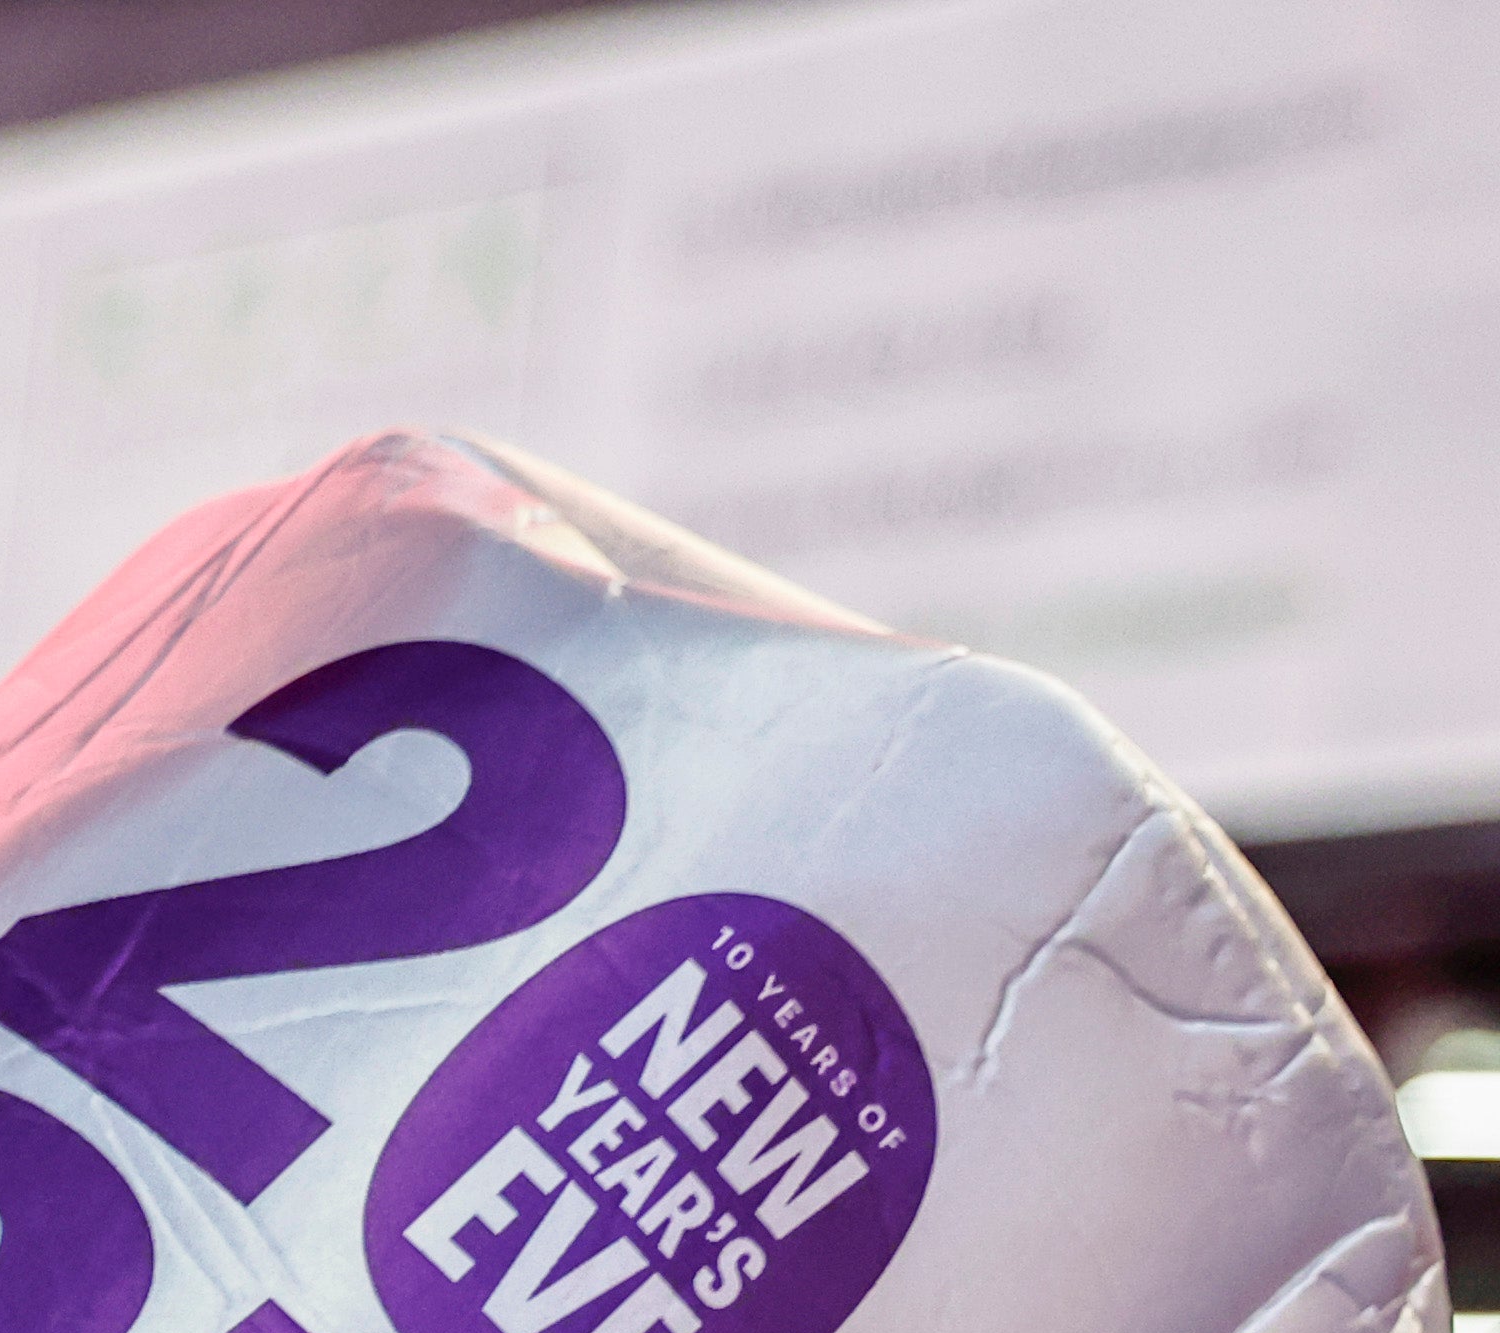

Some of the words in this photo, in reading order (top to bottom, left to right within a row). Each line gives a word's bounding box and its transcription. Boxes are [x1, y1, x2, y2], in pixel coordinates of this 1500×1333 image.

[598, 956, 871, 1241] NEW
[710, 924, 754, 971] 10
[757, 971, 859, 1098] YEARS
[857, 1103, 908, 1151] OF
[535, 1051, 768, 1310] YEAR'S
